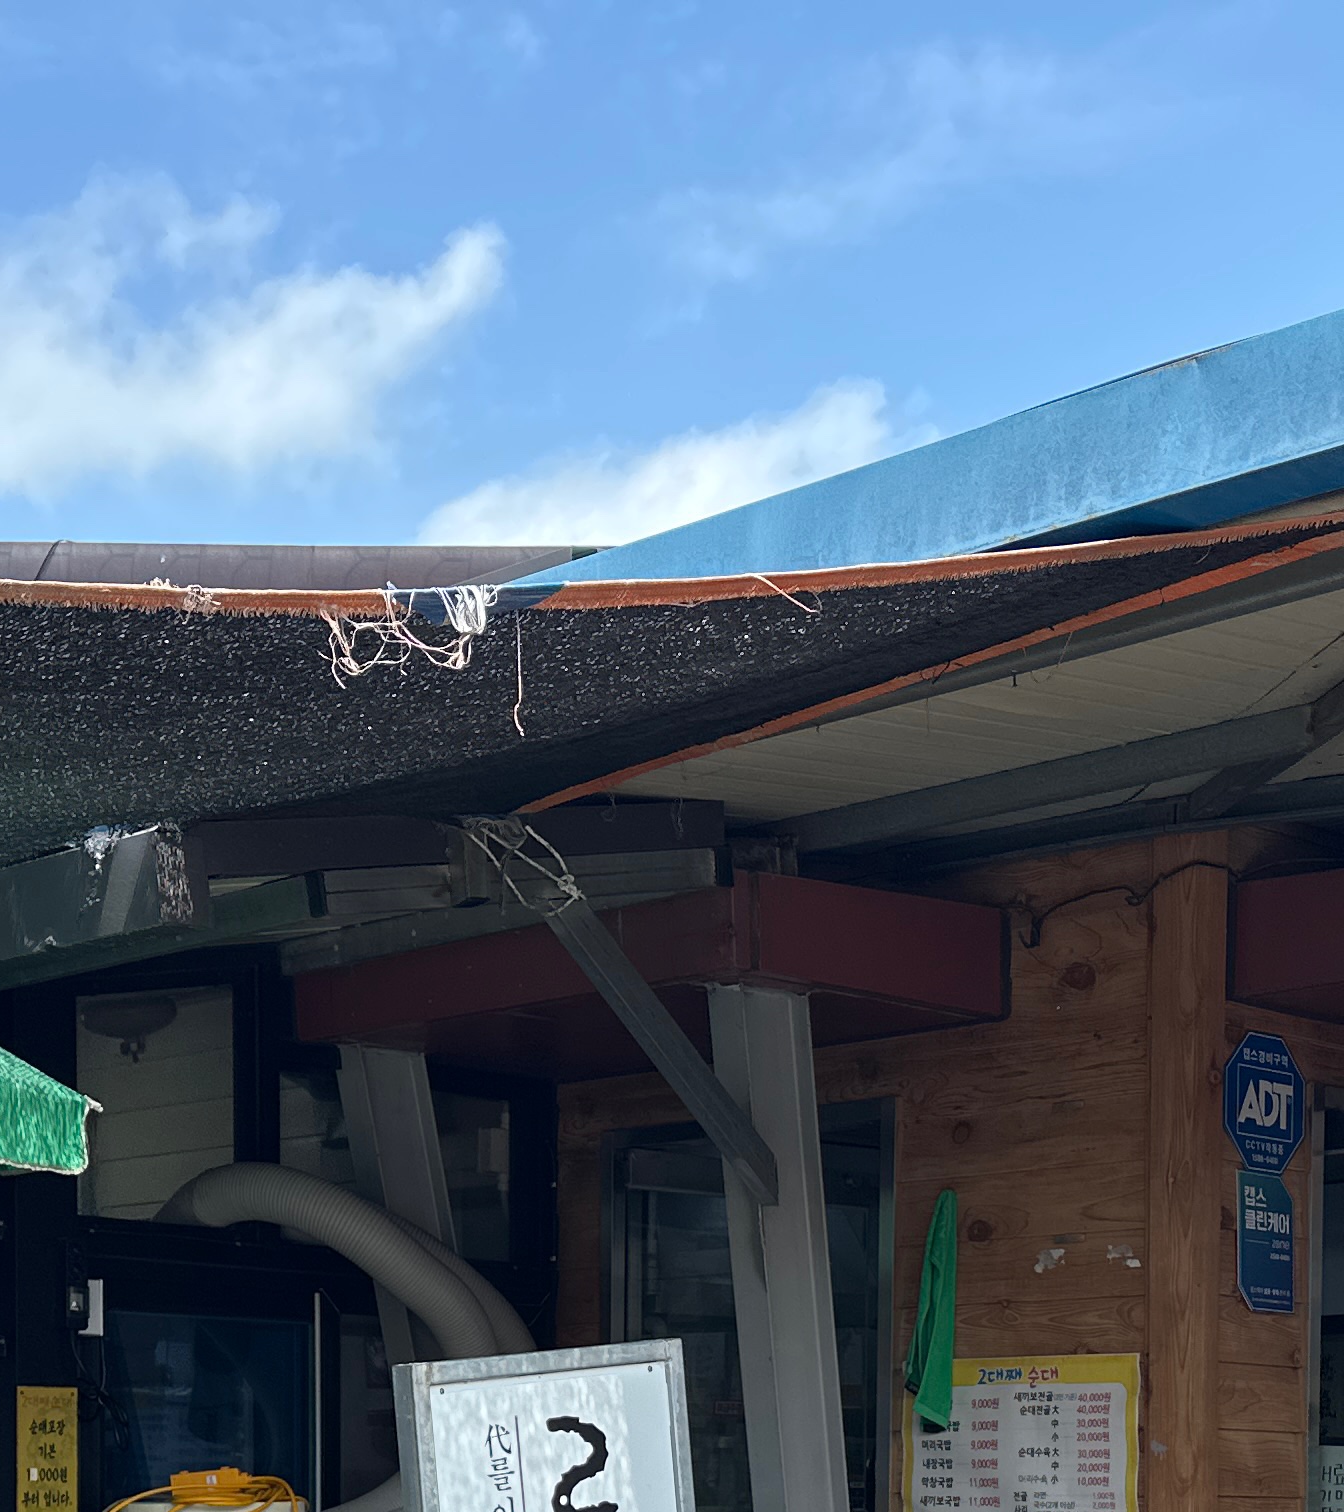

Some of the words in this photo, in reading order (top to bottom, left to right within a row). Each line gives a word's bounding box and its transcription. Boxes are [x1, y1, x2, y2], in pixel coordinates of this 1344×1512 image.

[1237, 1079, 1294, 1130] ADT
[1244, 1185, 1267, 1208] 캡스
[1244, 1209, 1290, 1235] 클린케어
[977, 1367, 1023, 1385] 2대째
[1027, 1365, 1059, 1389] 순대
[971, 1397, 1000, 1410] 9,000원
[1013, 1391, 1054, 1403] 새끼보전골
[1077, 1391, 1112, 1403] 40,000원
[1019, 1404, 1051, 1416] 순대전골
[1076, 1403, 1111, 1416] 40,000원
[28, 1418, 66, 1436] 순대포장
[971, 1419, 999, 1432] 9,000원
[1076, 1417, 1110, 1429] 30,000원
[1076, 1431, 1110, 1443] 20,000원
[38, 1441, 57, 1460] 기본
[921, 1439, 952, 1451] 머리국밥
[970, 1439, 999, 1451] 9,000원
[1017, 1446, 1051, 1458] 순대수육
[1076, 1448, 1111, 1460] 30,000원
[922, 1457, 954, 1470] 내장국밥
[970, 1457, 999, 1470] 9,000원
[1076, 1462, 1111, 1473] 20,000원
[921, 1476, 954, 1489] 막창국밥
[969, 1477, 1000, 1490] 11,000원
[1077, 1475, 1110, 1487] 10,000원
[21, 1489, 40, 1508] 부터
[919, 1495, 961, 1507] 새끼보국밥
[968, 1495, 1001, 1508] 11,000원
[1013, 1491, 1028, 1502] 전골
[1092, 1501, 1117, 1511] 2,000원
